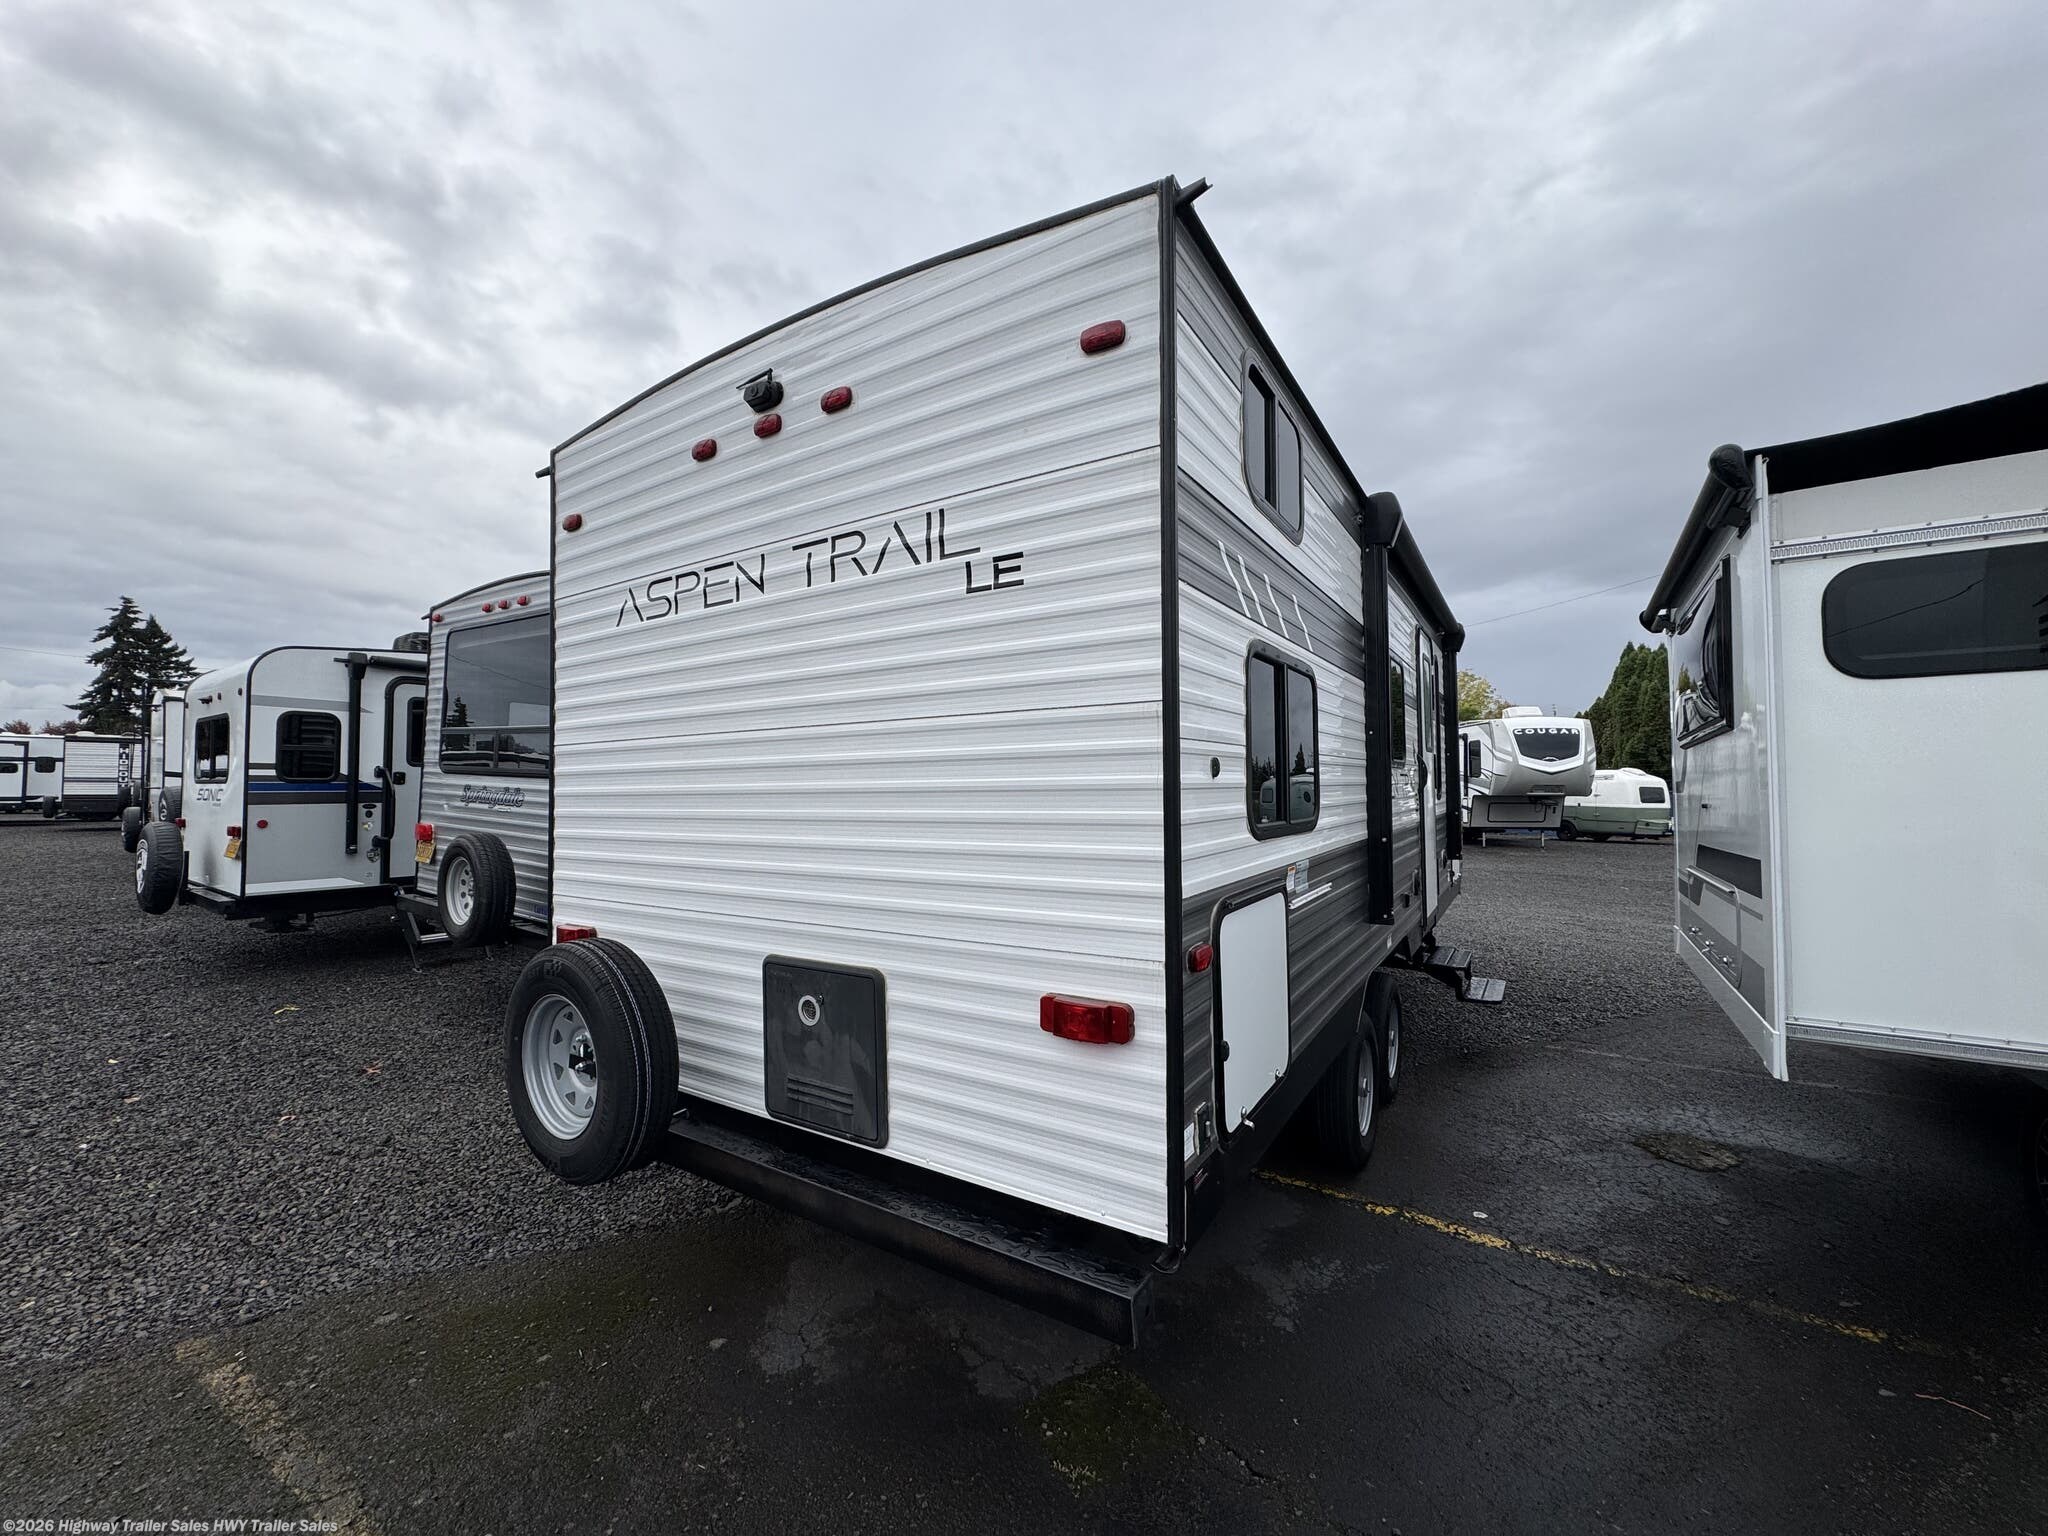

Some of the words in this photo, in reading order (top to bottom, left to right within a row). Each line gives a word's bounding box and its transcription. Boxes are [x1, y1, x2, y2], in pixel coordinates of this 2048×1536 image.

[616, 553, 766, 628] ASPEN
[791, 507, 982, 588] TRAIL
[965, 551, 1025, 595] LE
[118, 747, 129, 788] HIDEOUT
[196, 788, 224, 802] SONIC
[460, 784, 526, 808] Springdale
